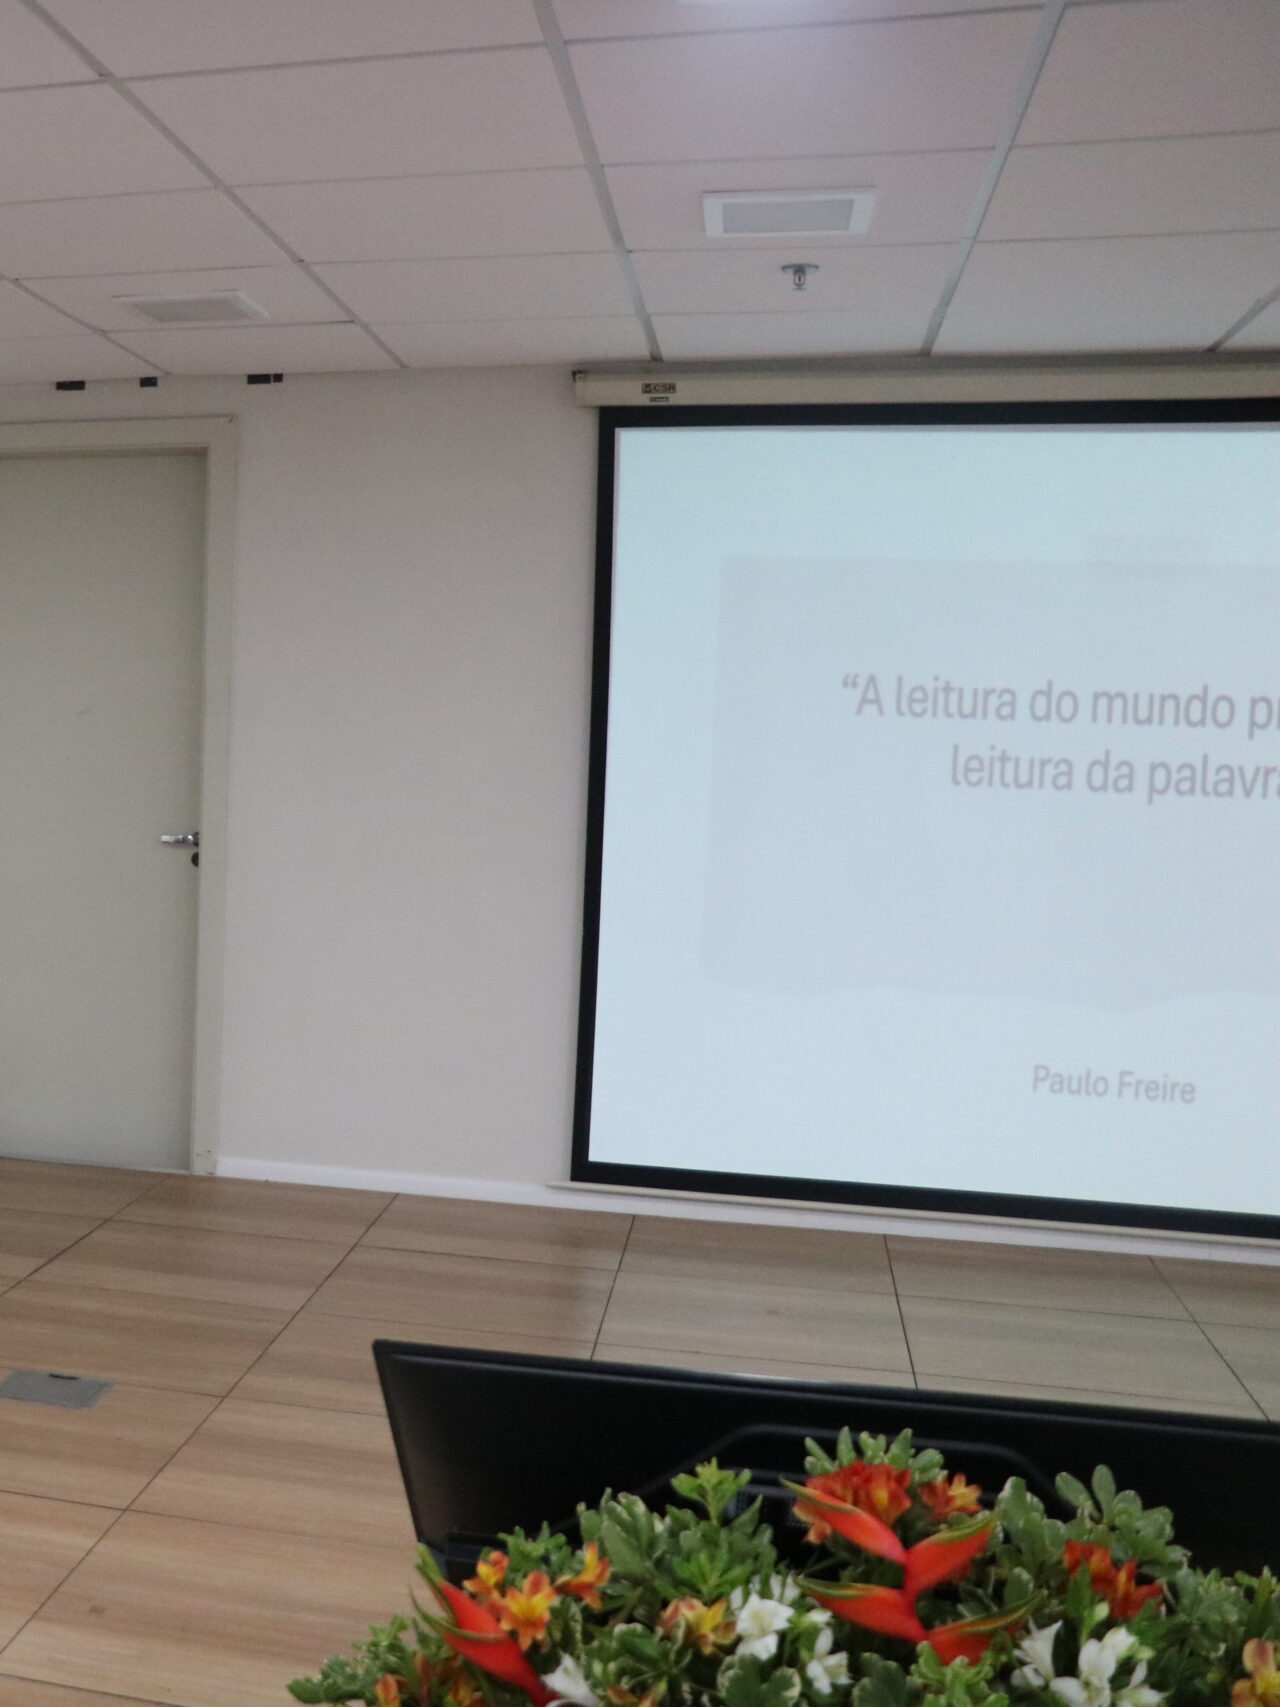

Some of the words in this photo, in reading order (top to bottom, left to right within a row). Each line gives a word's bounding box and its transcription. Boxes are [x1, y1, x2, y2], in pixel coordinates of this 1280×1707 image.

[895, 674, 1018, 722] leitura
[1028, 679, 1080, 724] do
[1091, 684, 1236, 730] mundo
[950, 743, 1074, 792] leitura
[1085, 748, 1136, 795] da
[1147, 753, 1280, 806] palavr
[1032, 1063, 1110, 1098] Paulo
[1117, 1069, 1197, 1105] Freire
